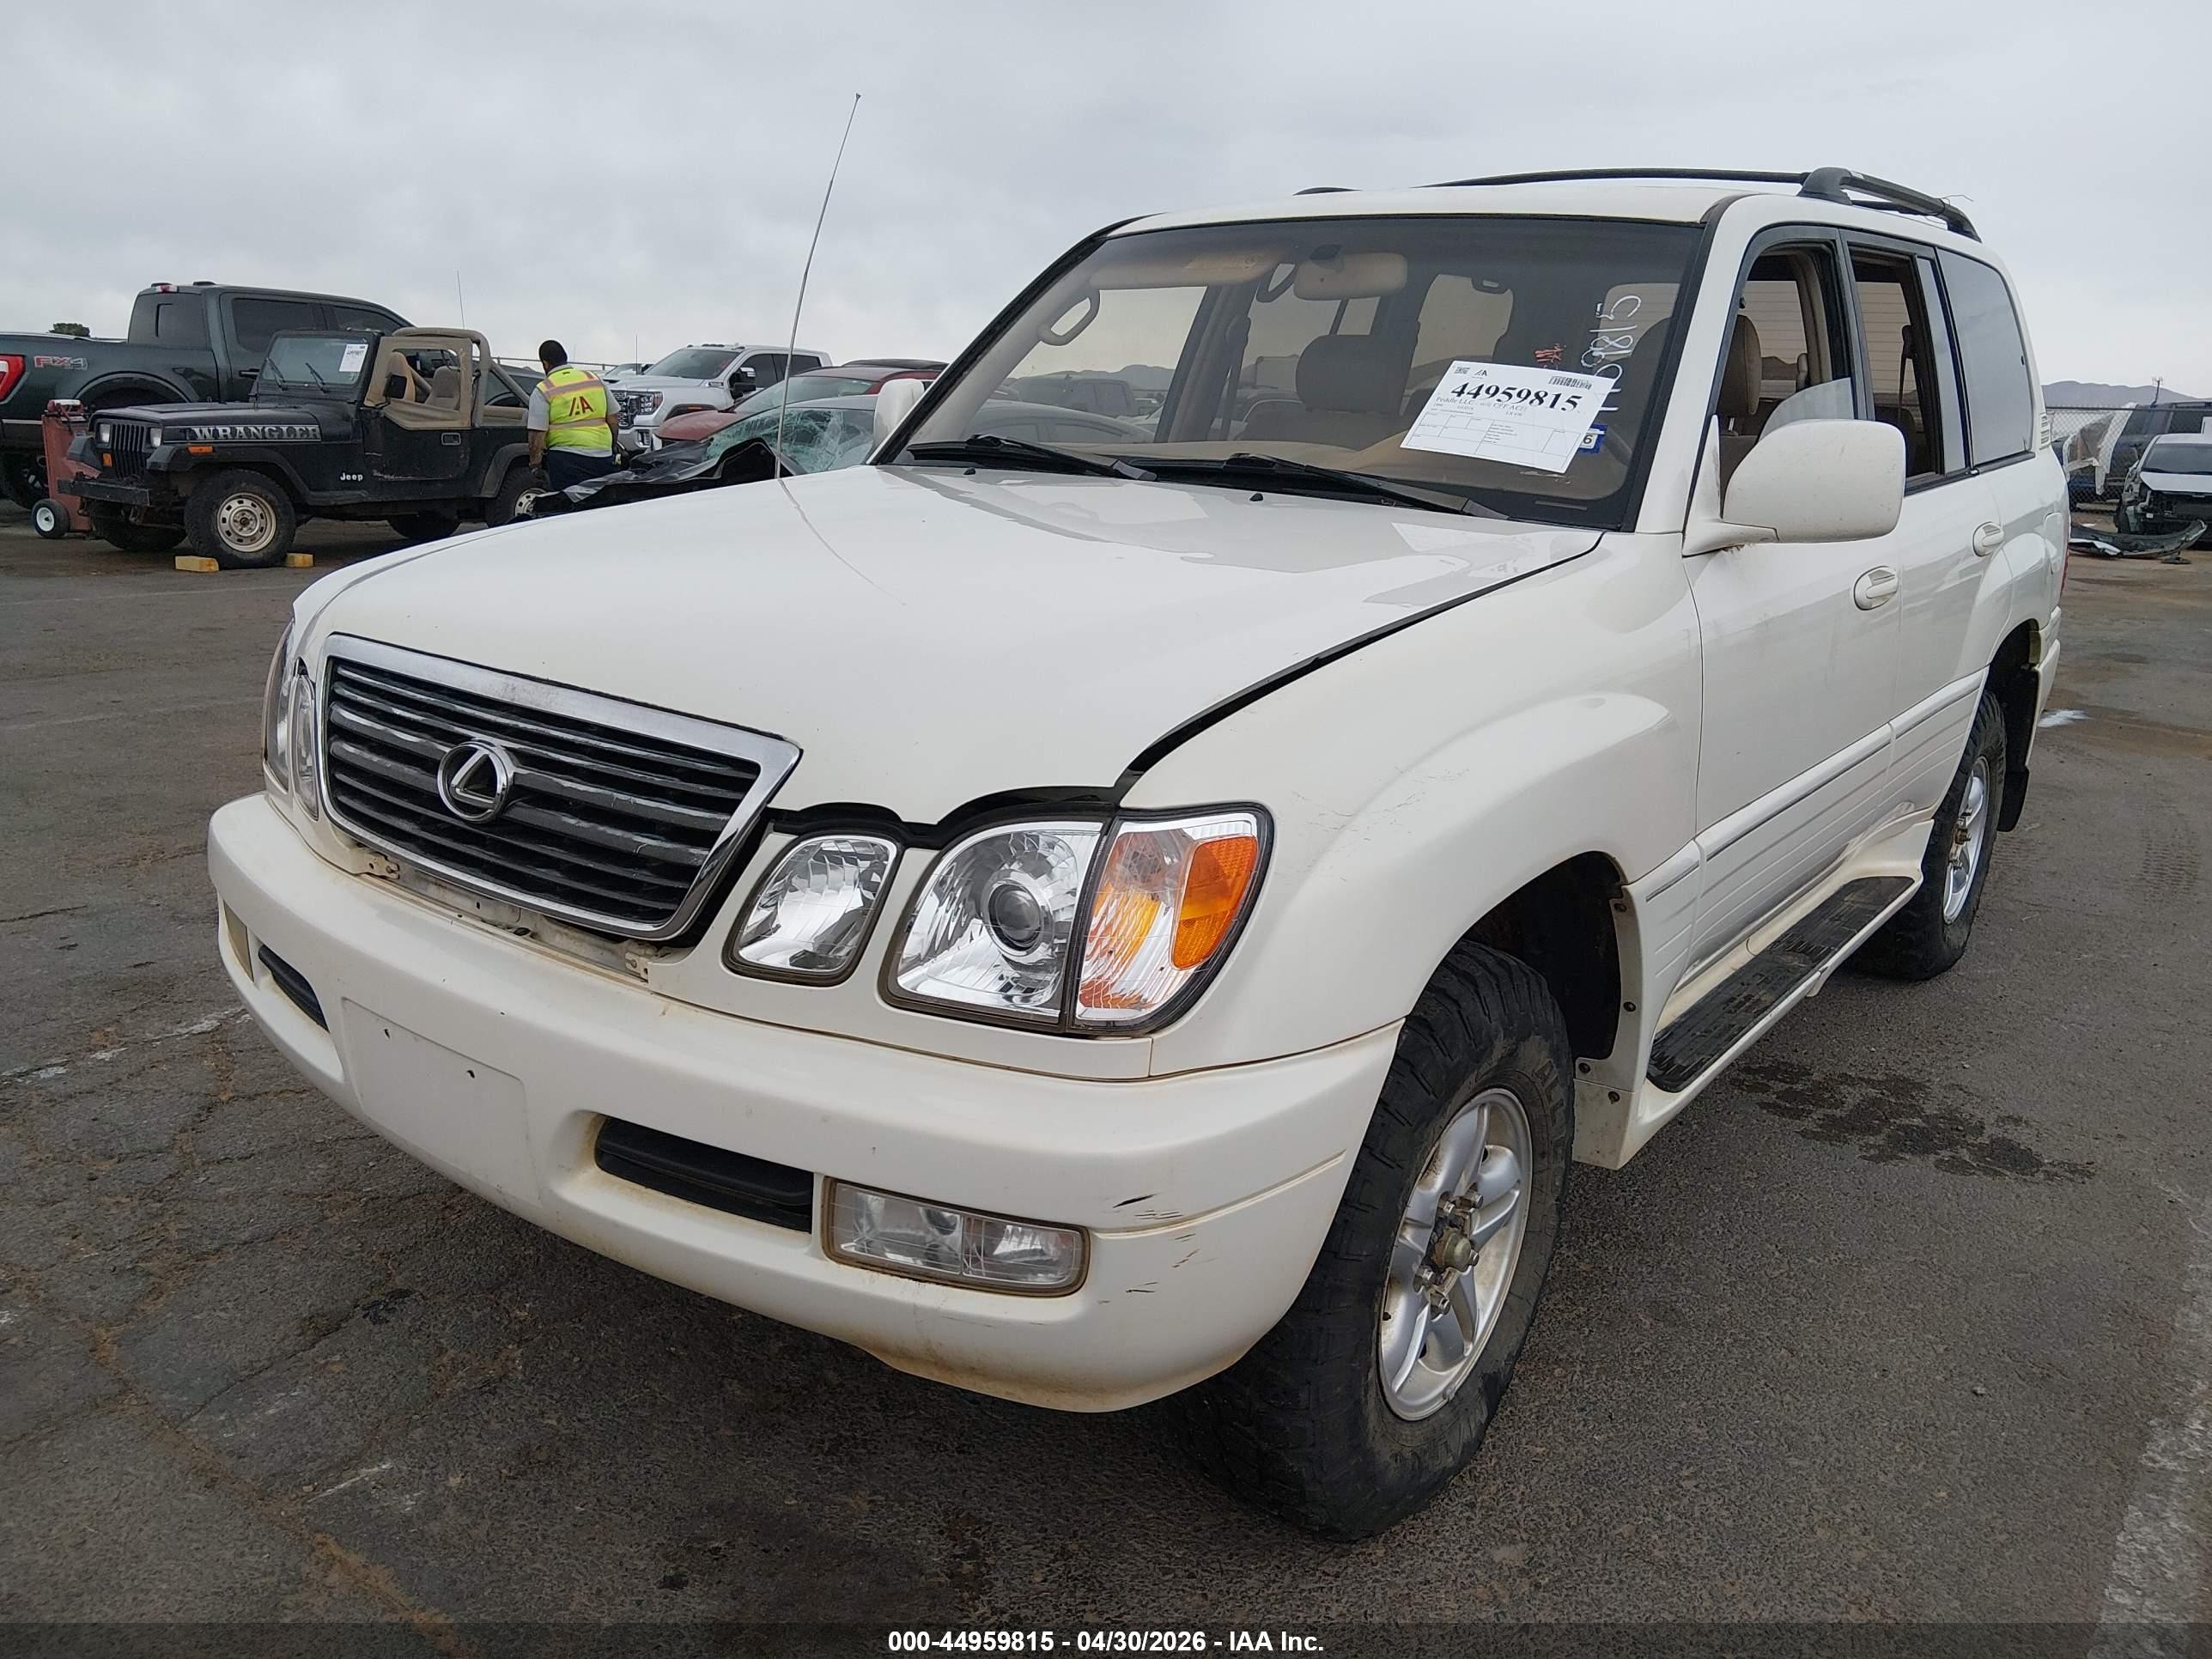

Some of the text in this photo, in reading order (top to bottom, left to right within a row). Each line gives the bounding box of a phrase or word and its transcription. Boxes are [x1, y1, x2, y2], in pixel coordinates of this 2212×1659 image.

[33, 355, 88, 371] FX4
[1450, 381, 1583, 412] 44959815
[191, 425, 321, 440] WRANGLER
[340, 472, 363, 483] Jeep
